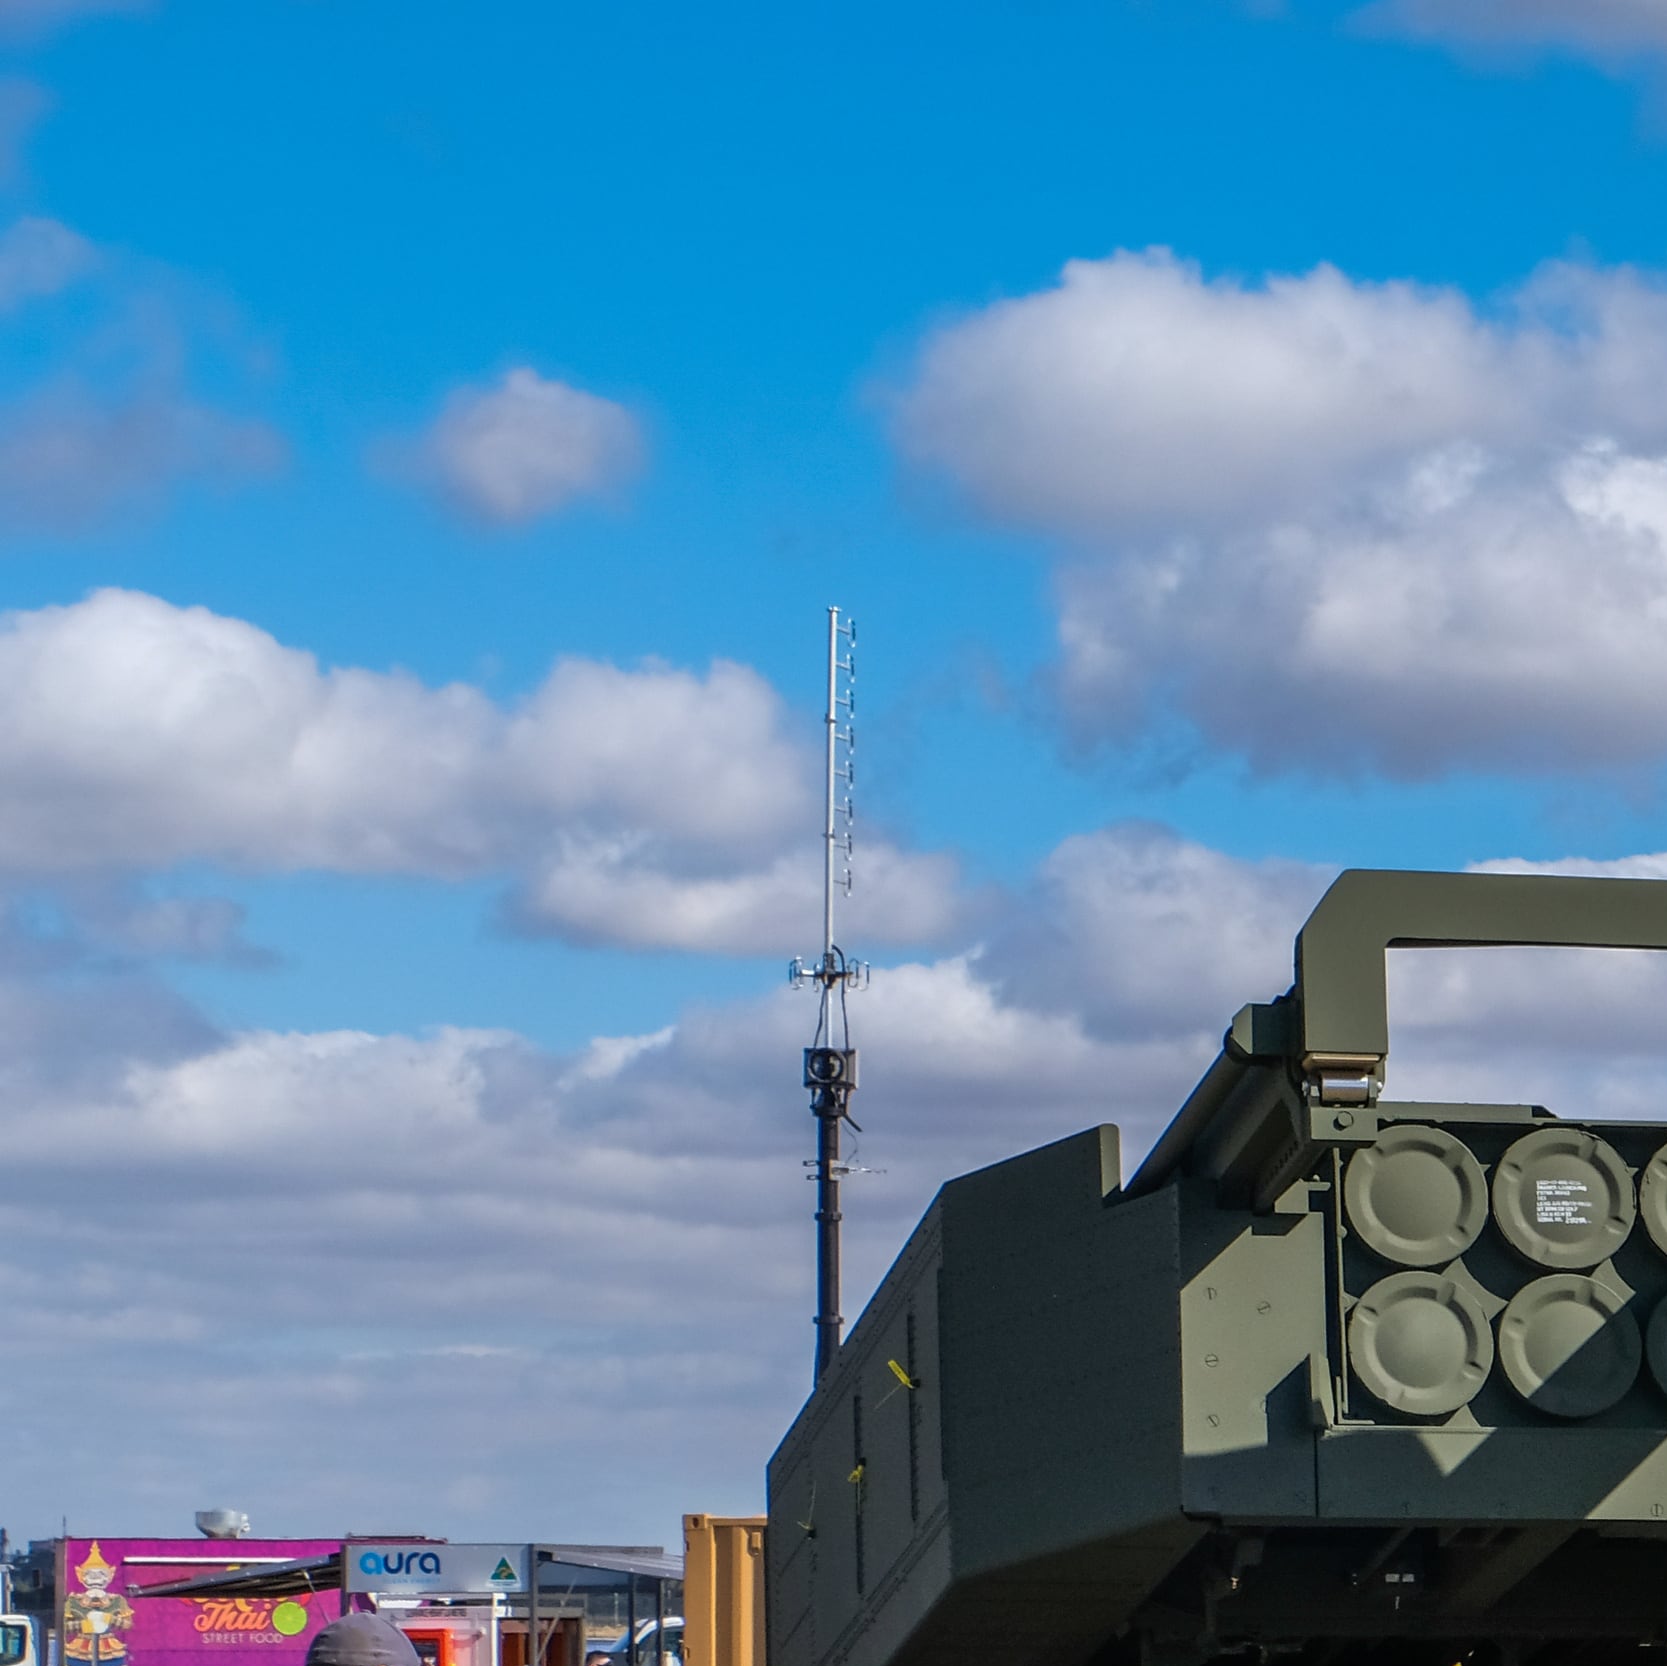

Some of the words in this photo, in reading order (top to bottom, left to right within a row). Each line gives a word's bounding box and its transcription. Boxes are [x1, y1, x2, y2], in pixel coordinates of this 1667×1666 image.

[359, 1552, 440, 1575] aura
[194, 1602, 270, 1631] Thai
[202, 1633, 243, 1644] STREET
[250, 1633, 282, 1644] FOOD
